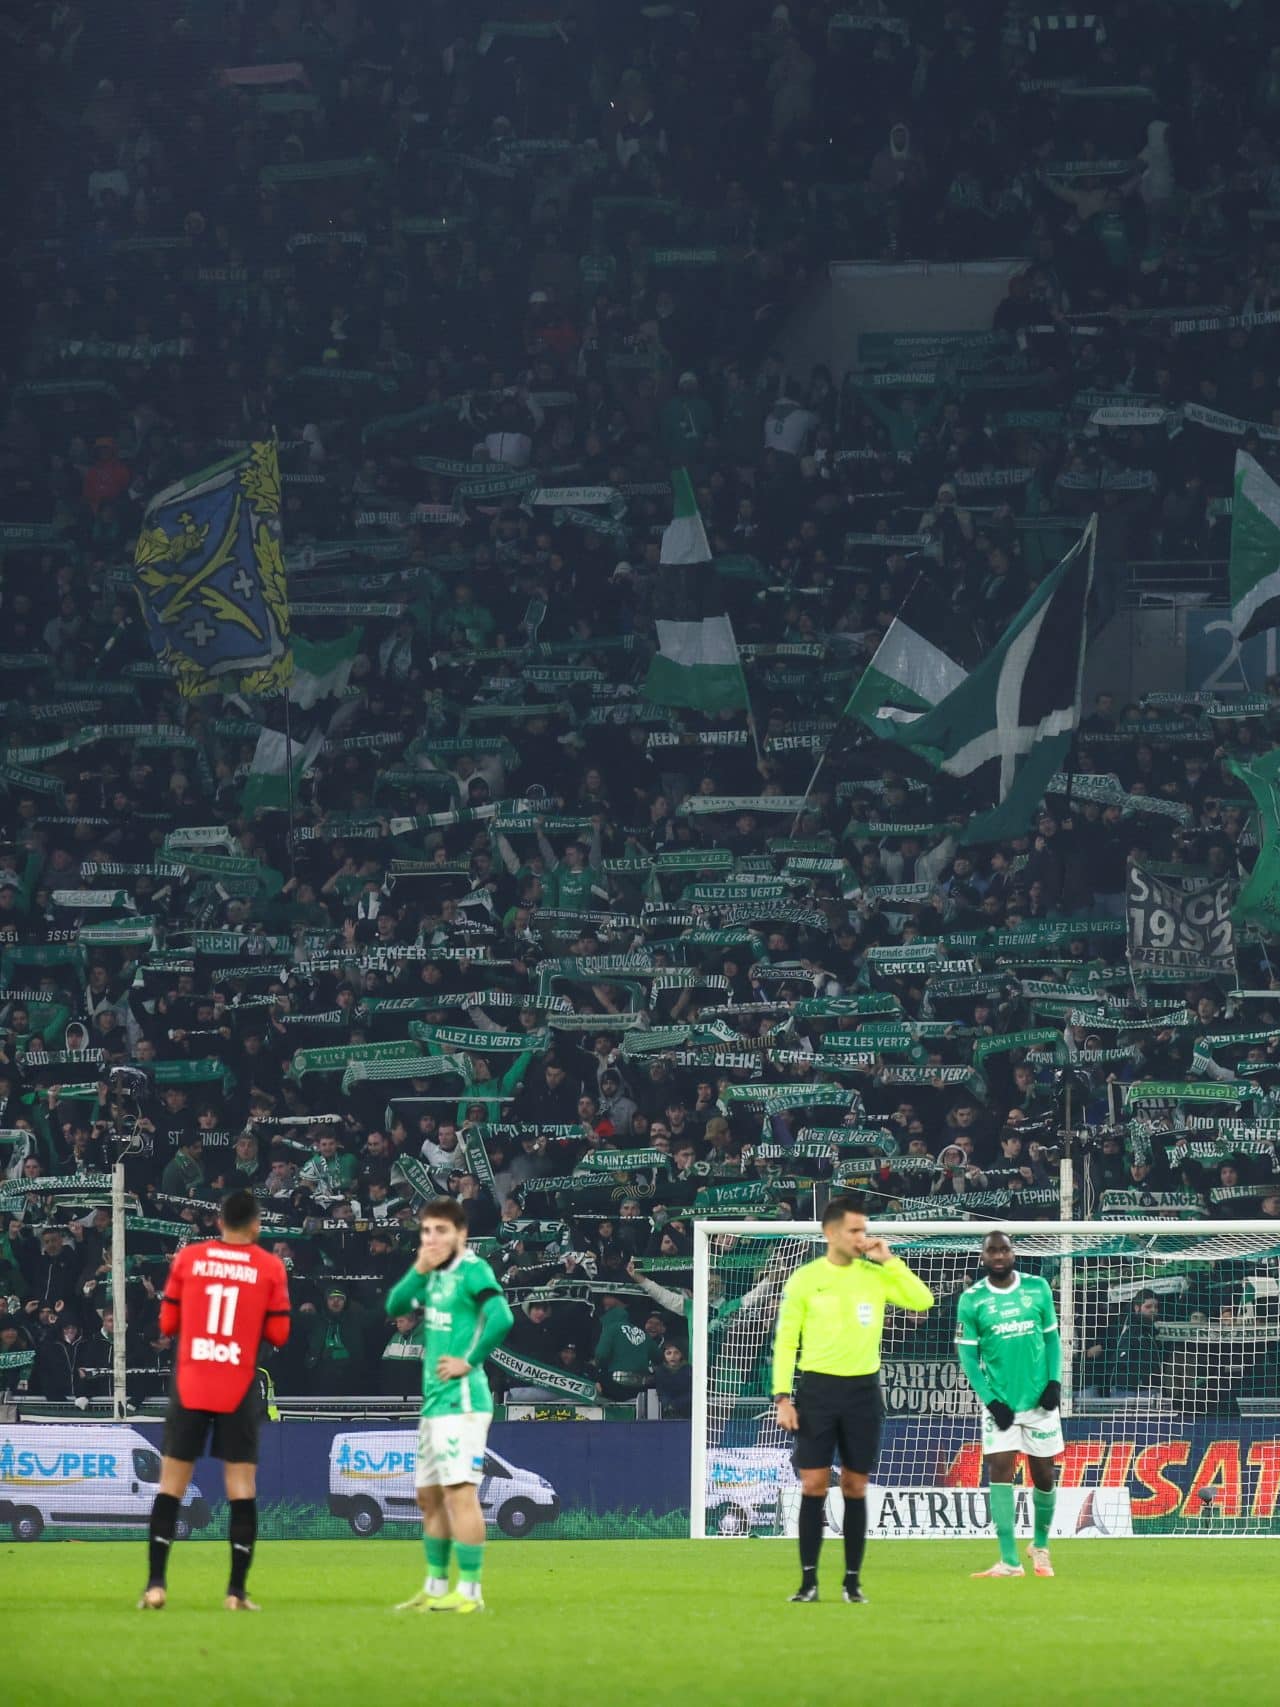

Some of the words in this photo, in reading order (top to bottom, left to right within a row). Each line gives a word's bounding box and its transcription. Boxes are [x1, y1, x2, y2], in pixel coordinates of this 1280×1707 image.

[1203, 620, 1278, 692] 21
[694, 887, 724, 899] ALLEZ
[727, 887, 744, 898] LES
[748, 886, 782, 898] VERTS
[998, 933, 1038, 946] ETIENNE
[375, 997, 415, 1010] ALLEZ
[435, 1029, 466, 1042] ALLEZ
[469, 1033, 488, 1046] LES
[490, 1034, 522, 1048] VERTS
[853, 1037, 870, 1049] LES
[873, 1036, 912, 1048] VERTS
[981, 1037, 1014, 1051] SAINT
[1015, 1030, 1058, 1044] ETIENNE
[26, 1050, 49, 1066] SUD
[837, 1051, 877, 1066] VERT
[732, 1085, 746, 1097] AS
[1130, 1084, 1176, 1100] Green
[1183, 1083, 1238, 1099] Angels
[797, 1129, 826, 1143] Allez
[829, 1130, 845, 1143] les
[847, 1130, 880, 1145] Verts
[582, 1152, 595, 1165] AS
[597, 1153, 667, 1167] SAINT-ETIENNE
[717, 1185, 742, 1202] Vert
[1015, 1188, 1060, 1204] TÉPHAN
[206, 1283, 239, 1337] 11
[190, 1336, 242, 1366] Blot
[492, 1348, 524, 1373] GREEN
[525, 1362, 568, 1388] ANGELS
[568, 1381, 584, 1394] 92
[17, 1452, 117, 1478] SUPER
[353, 1451, 415, 1473] SUPE
